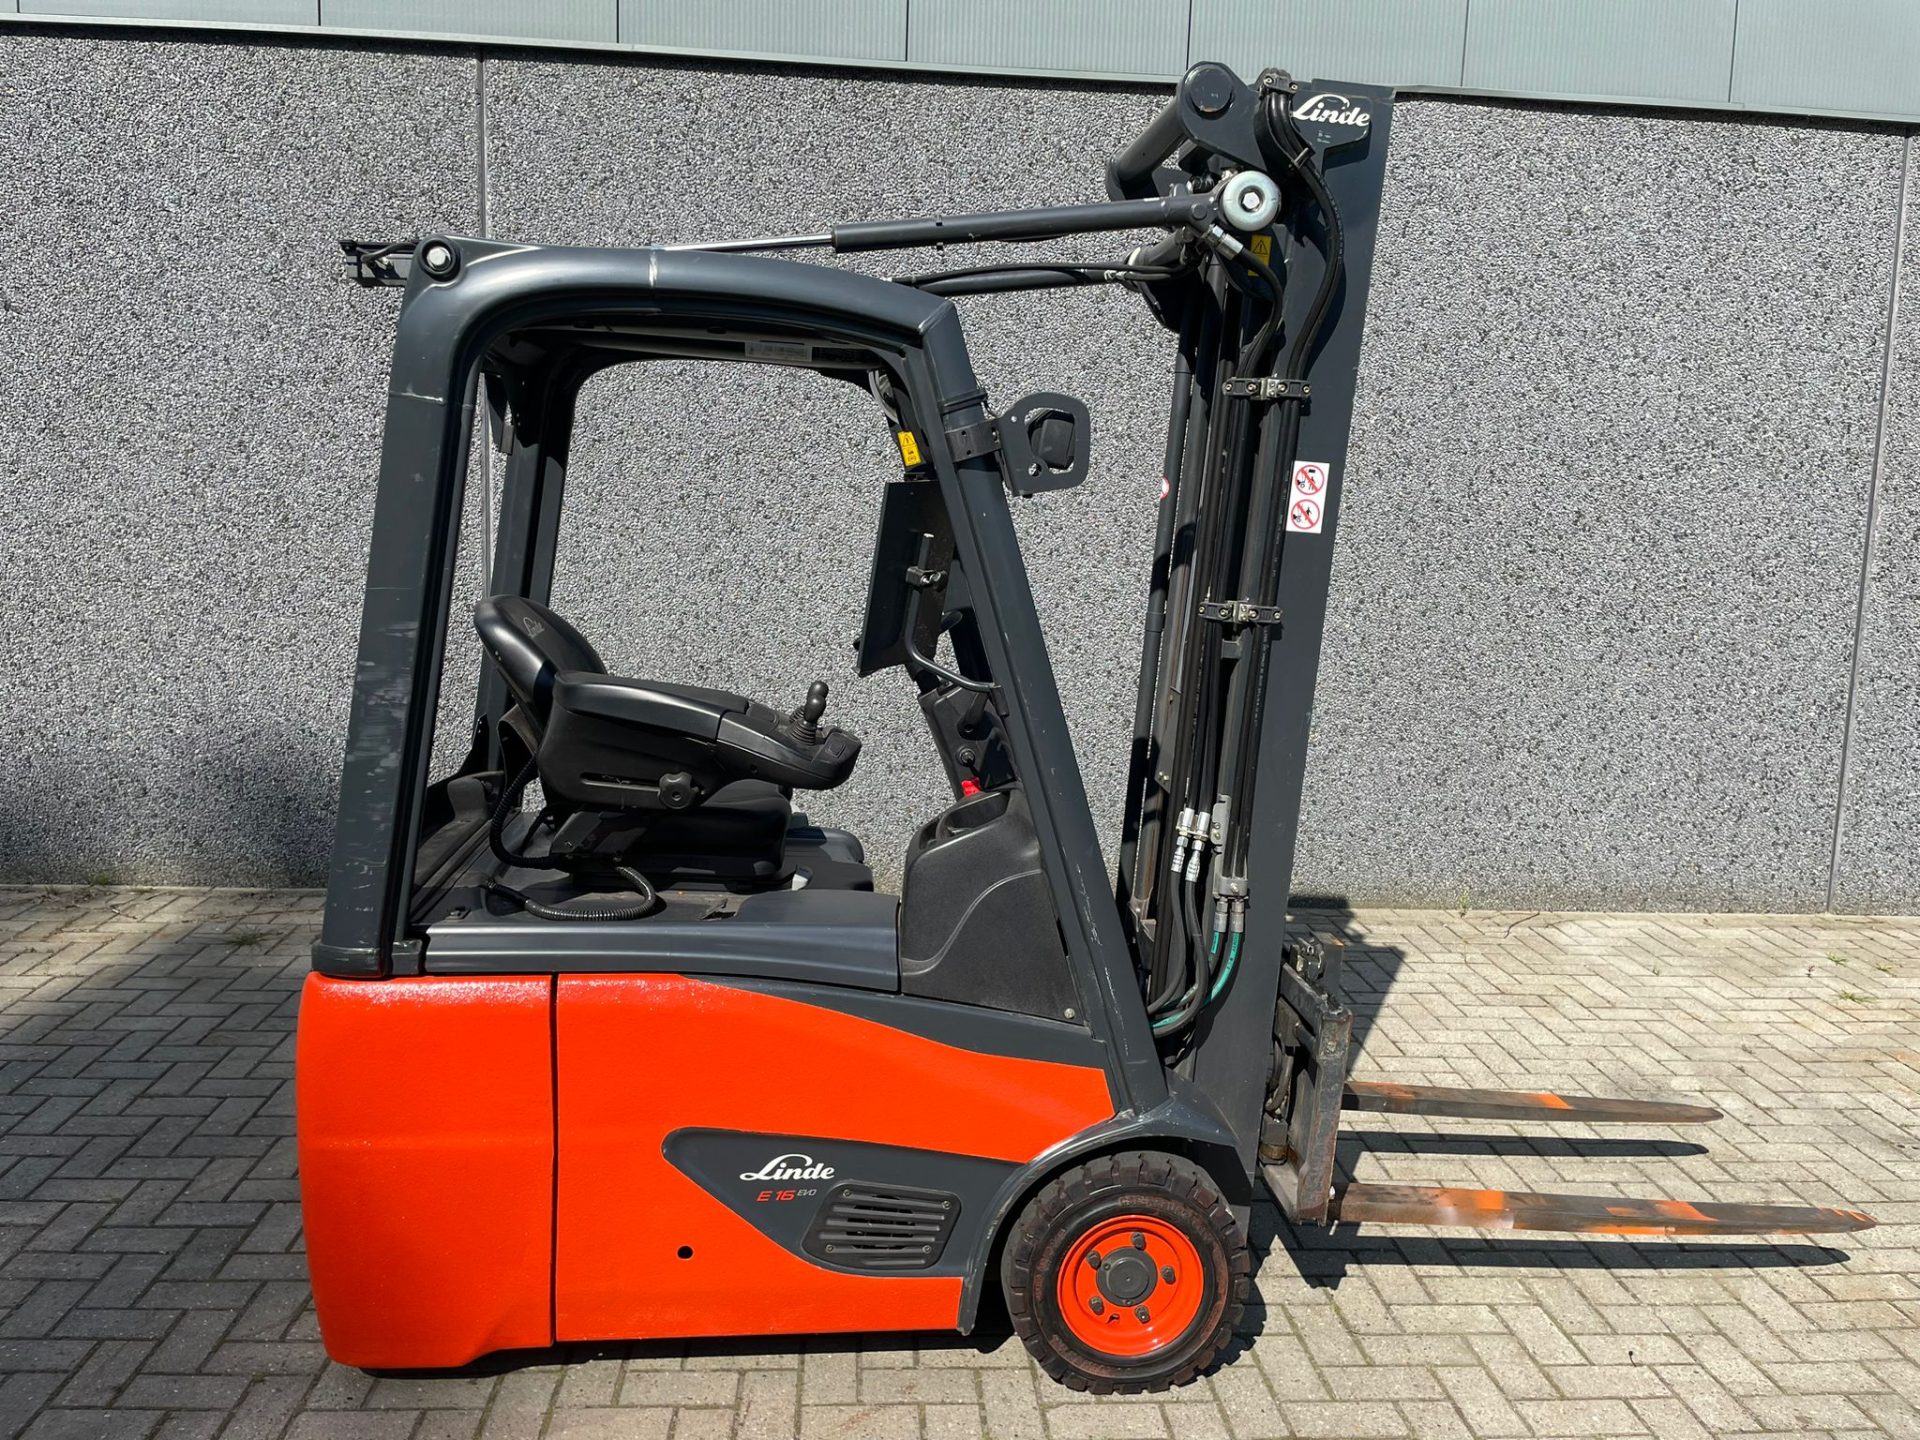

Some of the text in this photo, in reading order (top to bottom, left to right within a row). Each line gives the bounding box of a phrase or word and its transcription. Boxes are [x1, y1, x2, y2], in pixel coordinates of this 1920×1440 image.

[1293, 94, 1370, 127] Linde
[739, 1153, 835, 1180] Linde
[756, 1190, 772, 1202] E
[776, 1190, 796, 1201] 16
